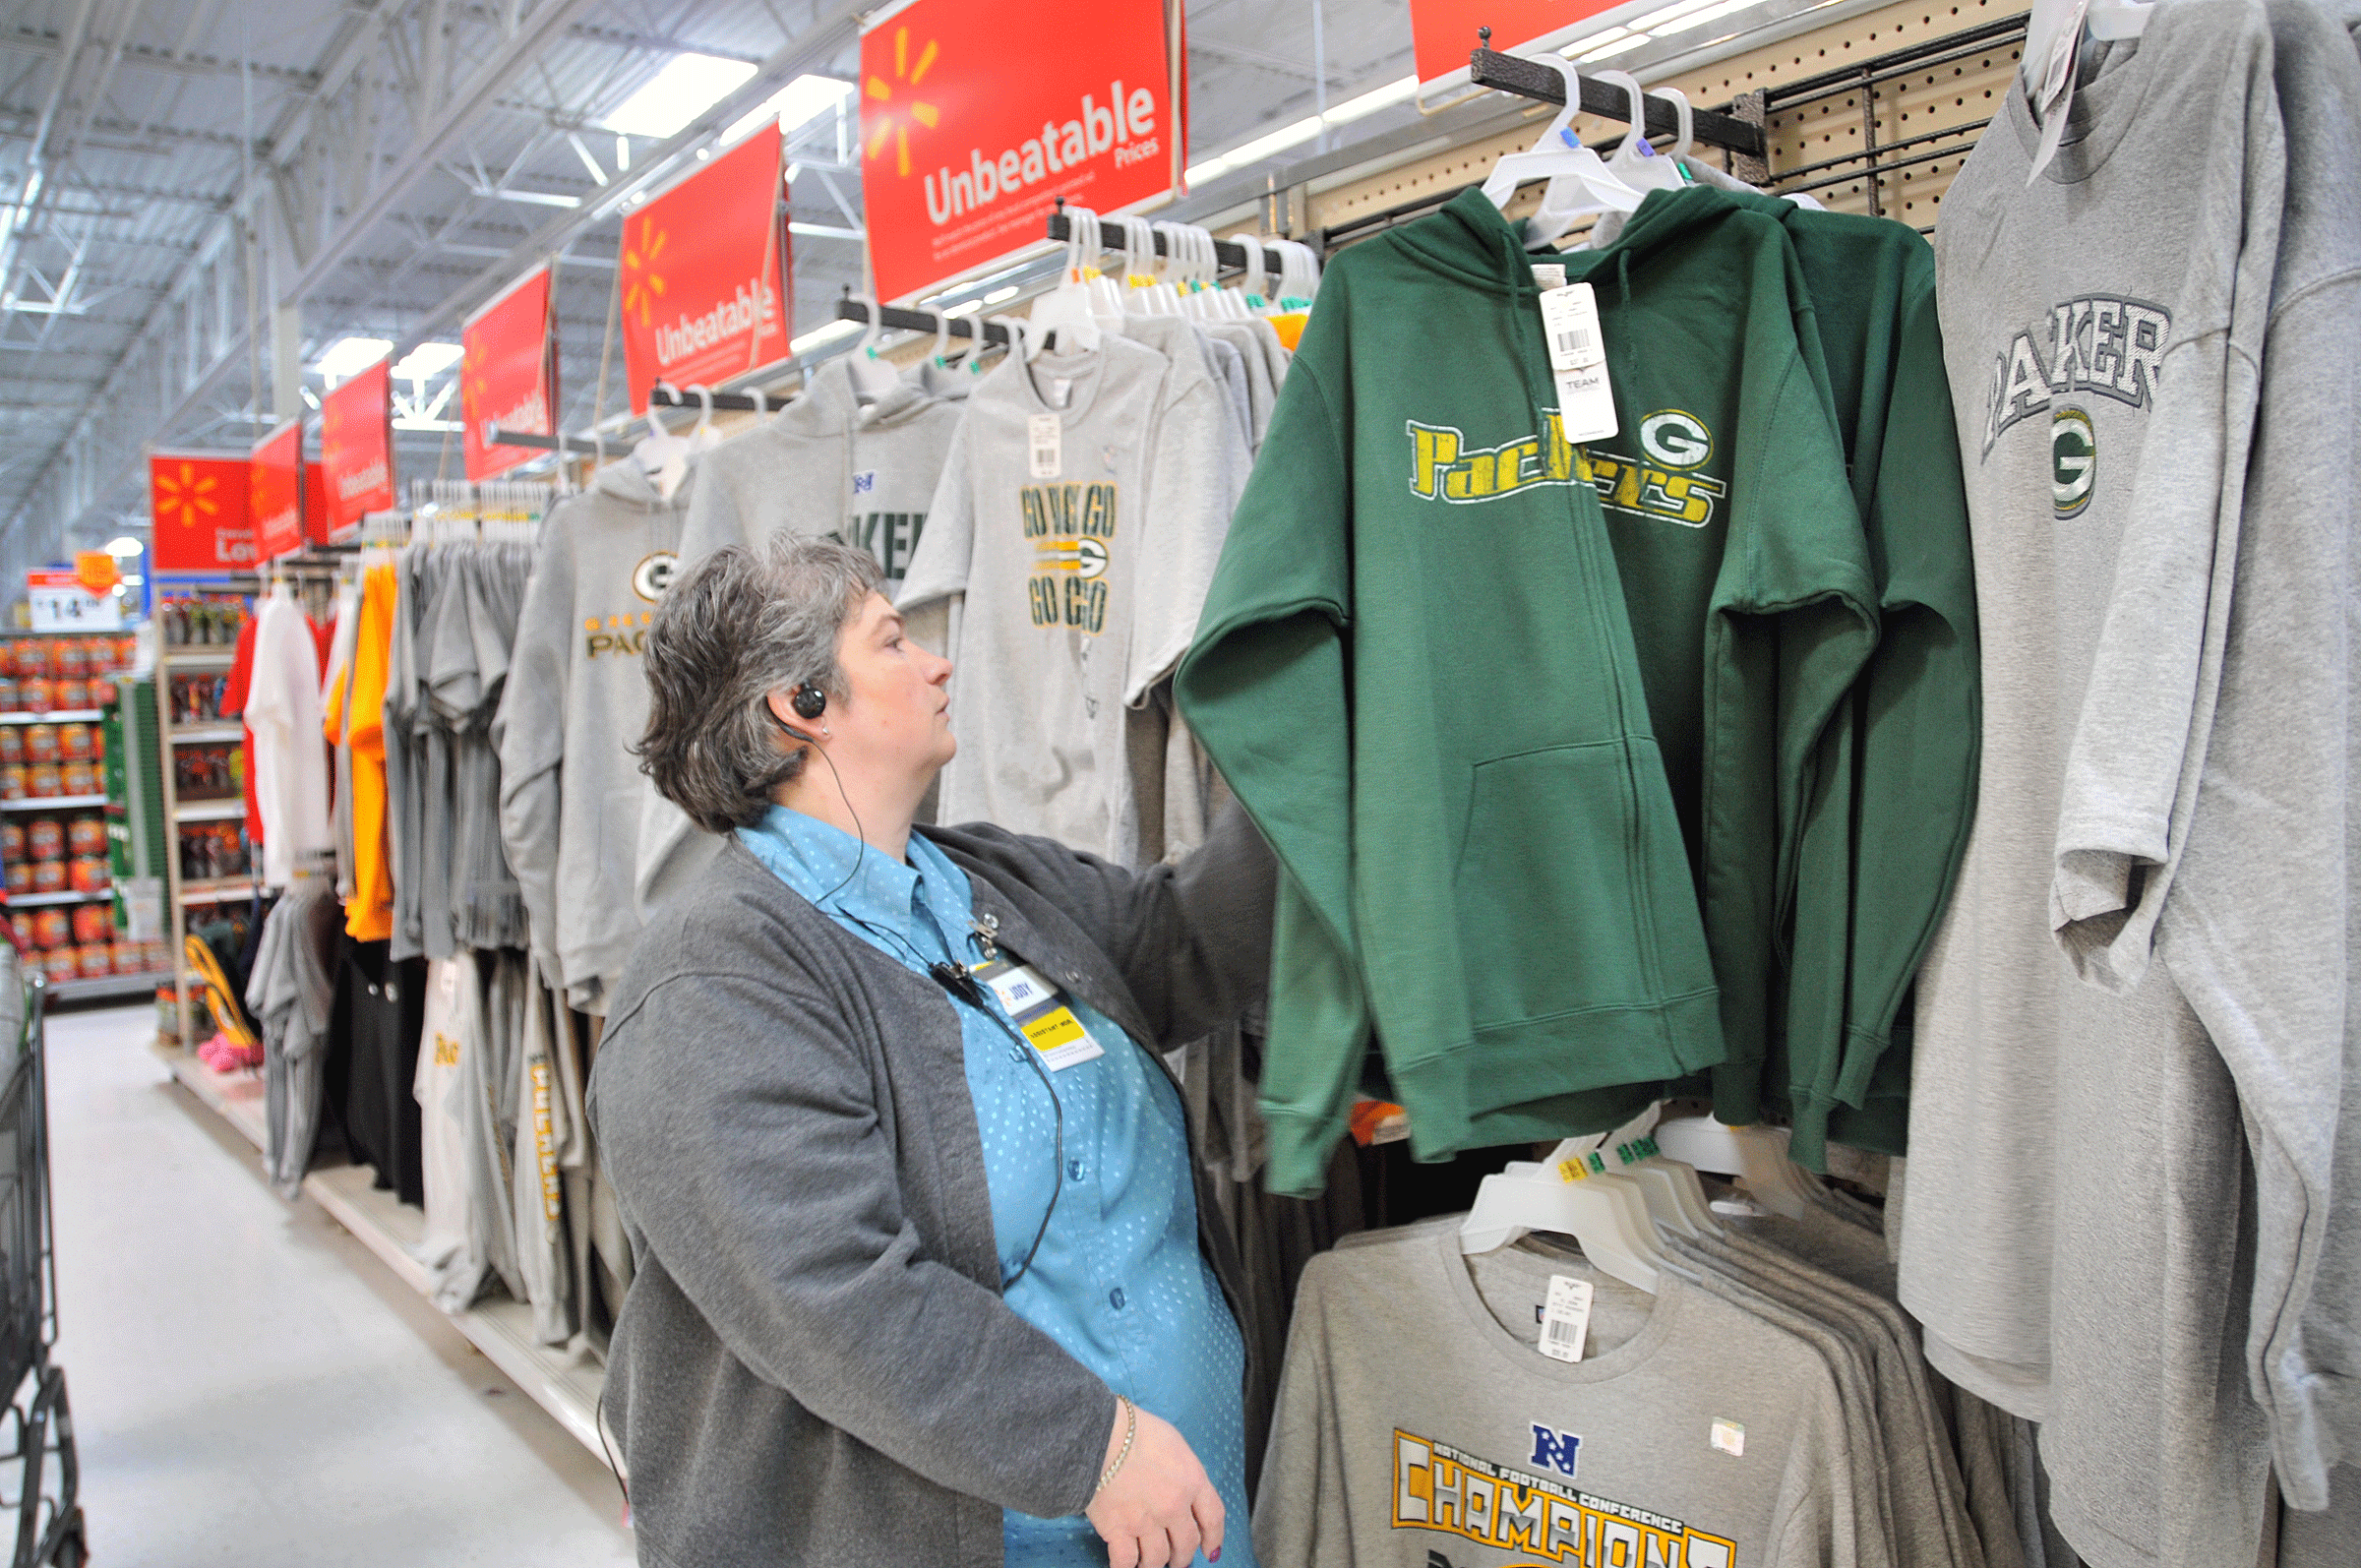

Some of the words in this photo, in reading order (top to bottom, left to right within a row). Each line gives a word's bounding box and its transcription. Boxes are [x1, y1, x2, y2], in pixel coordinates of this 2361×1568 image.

[925, 80, 1156, 225] Unbeatable
[1114, 137, 1160, 169] Prices
[655, 277, 775, 365] Unbeatable
[1566, 377, 1600, 390] TEAM
[1008, 983, 1033, 1000] JODY
[1529, 1421, 1582, 1479] N
[1433, 1442, 1496, 1477] NATIONAL
[1498, 1467, 1577, 1502] FOOTBALL
[1579, 1492, 1683, 1534] CONFERENCE
